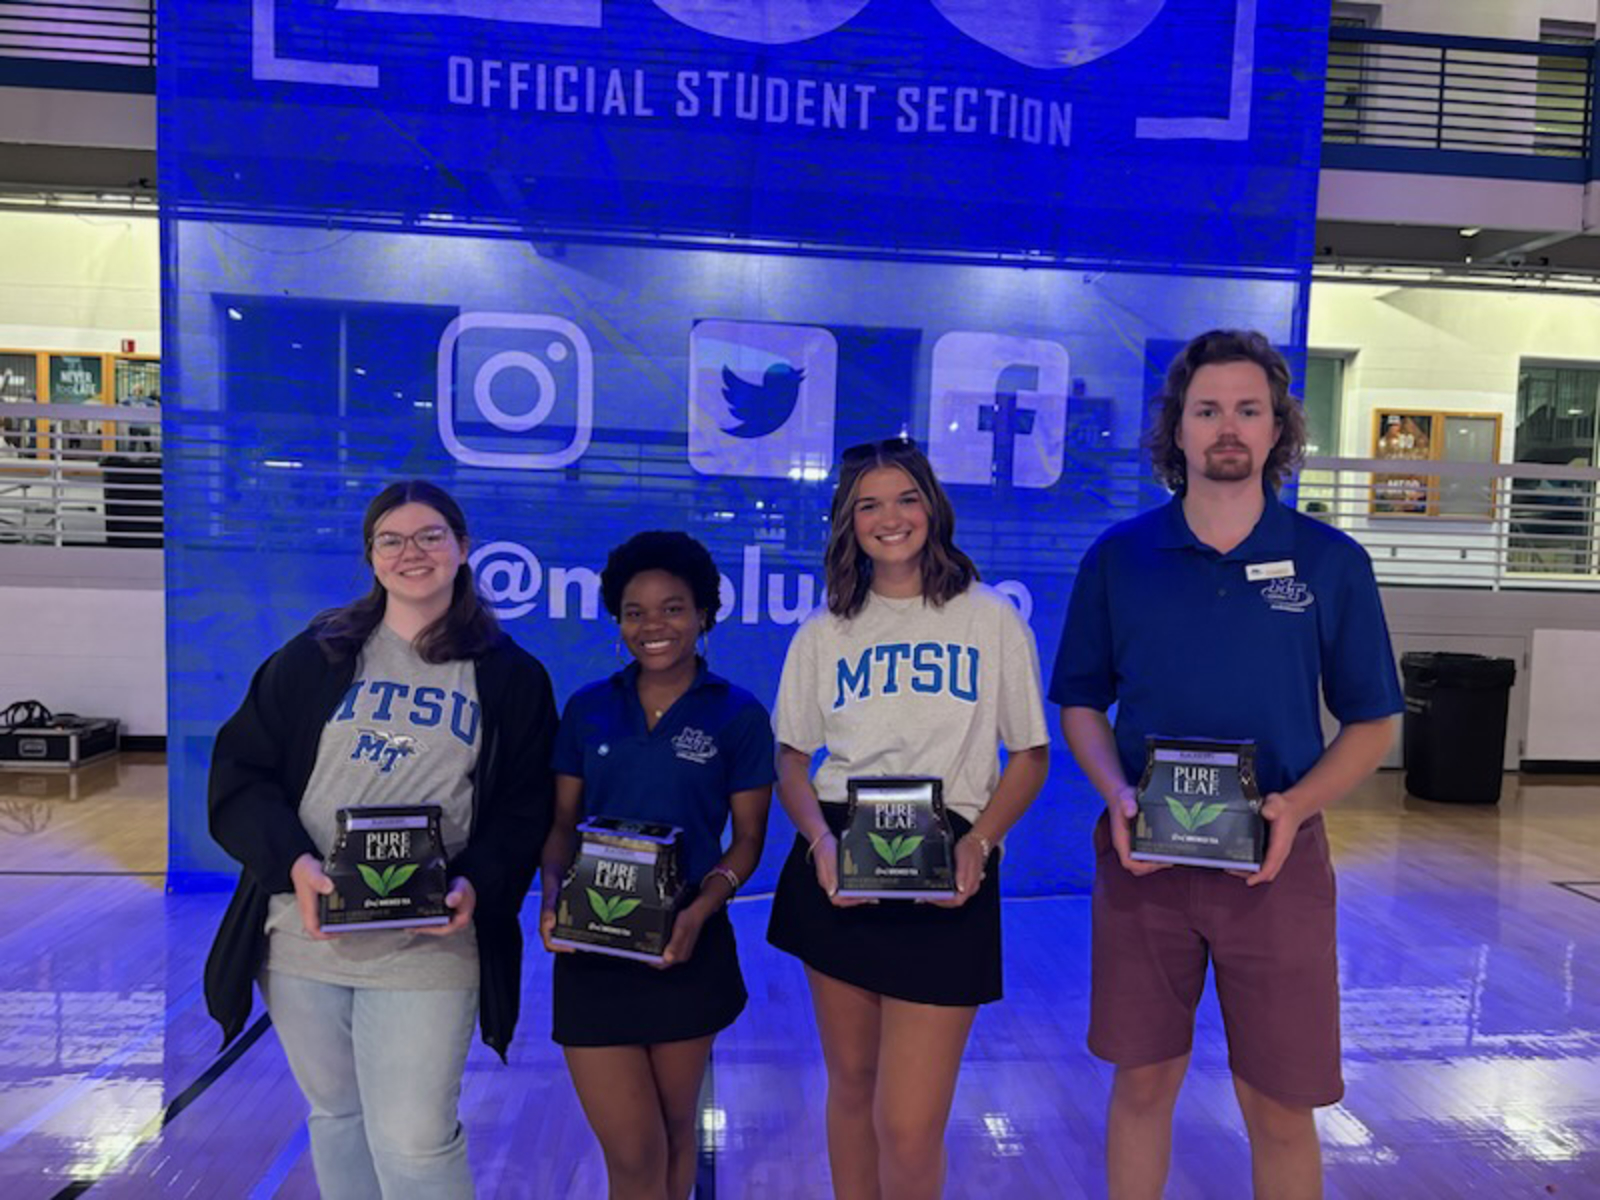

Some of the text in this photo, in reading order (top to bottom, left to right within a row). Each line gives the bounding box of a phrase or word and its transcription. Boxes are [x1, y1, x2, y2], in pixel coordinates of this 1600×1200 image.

[448, 55, 1072, 147] OFFICIAL STUDENT SECTION
[833, 641, 979, 709] MTSU
[1174, 766, 1220, 782] PURE
[1173, 780, 1218, 795] LEAF
[875, 803, 917, 817] PURE
[875, 816, 916, 829] LEAF
[366, 832, 411, 847] PURE
[366, 846, 410, 860] LEAF
[596, 860, 639, 878] PURE
[594, 874, 637, 892] LEAF
